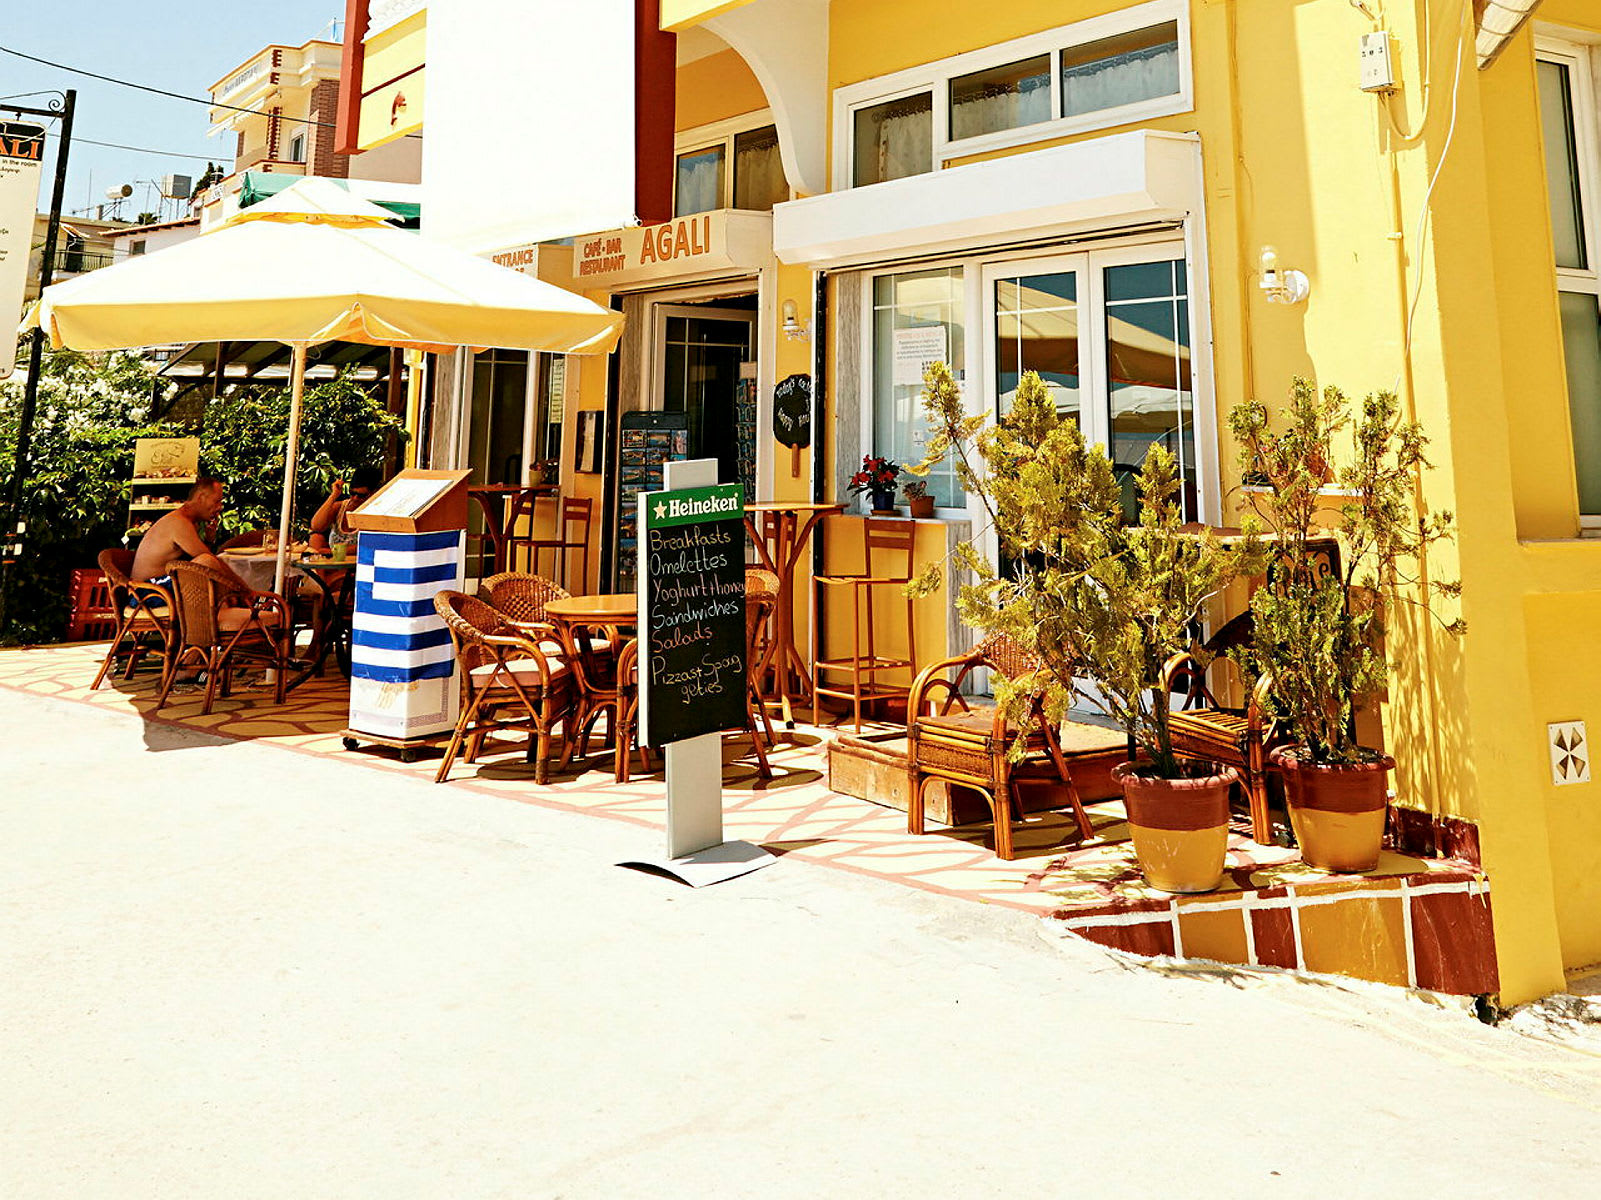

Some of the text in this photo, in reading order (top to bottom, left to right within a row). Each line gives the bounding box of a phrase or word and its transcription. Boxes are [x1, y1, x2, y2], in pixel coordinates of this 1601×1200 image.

[640, 216, 710, 265] AGALI
[580, 254, 626, 276] RESTAURANT
[668, 495, 738, 518] Heineken
[649, 524, 732, 552] Breakfasts
[650, 545, 728, 576] Omelettes
[652, 599, 739, 630] Sandwiches
[652, 620, 713, 653] Salads
